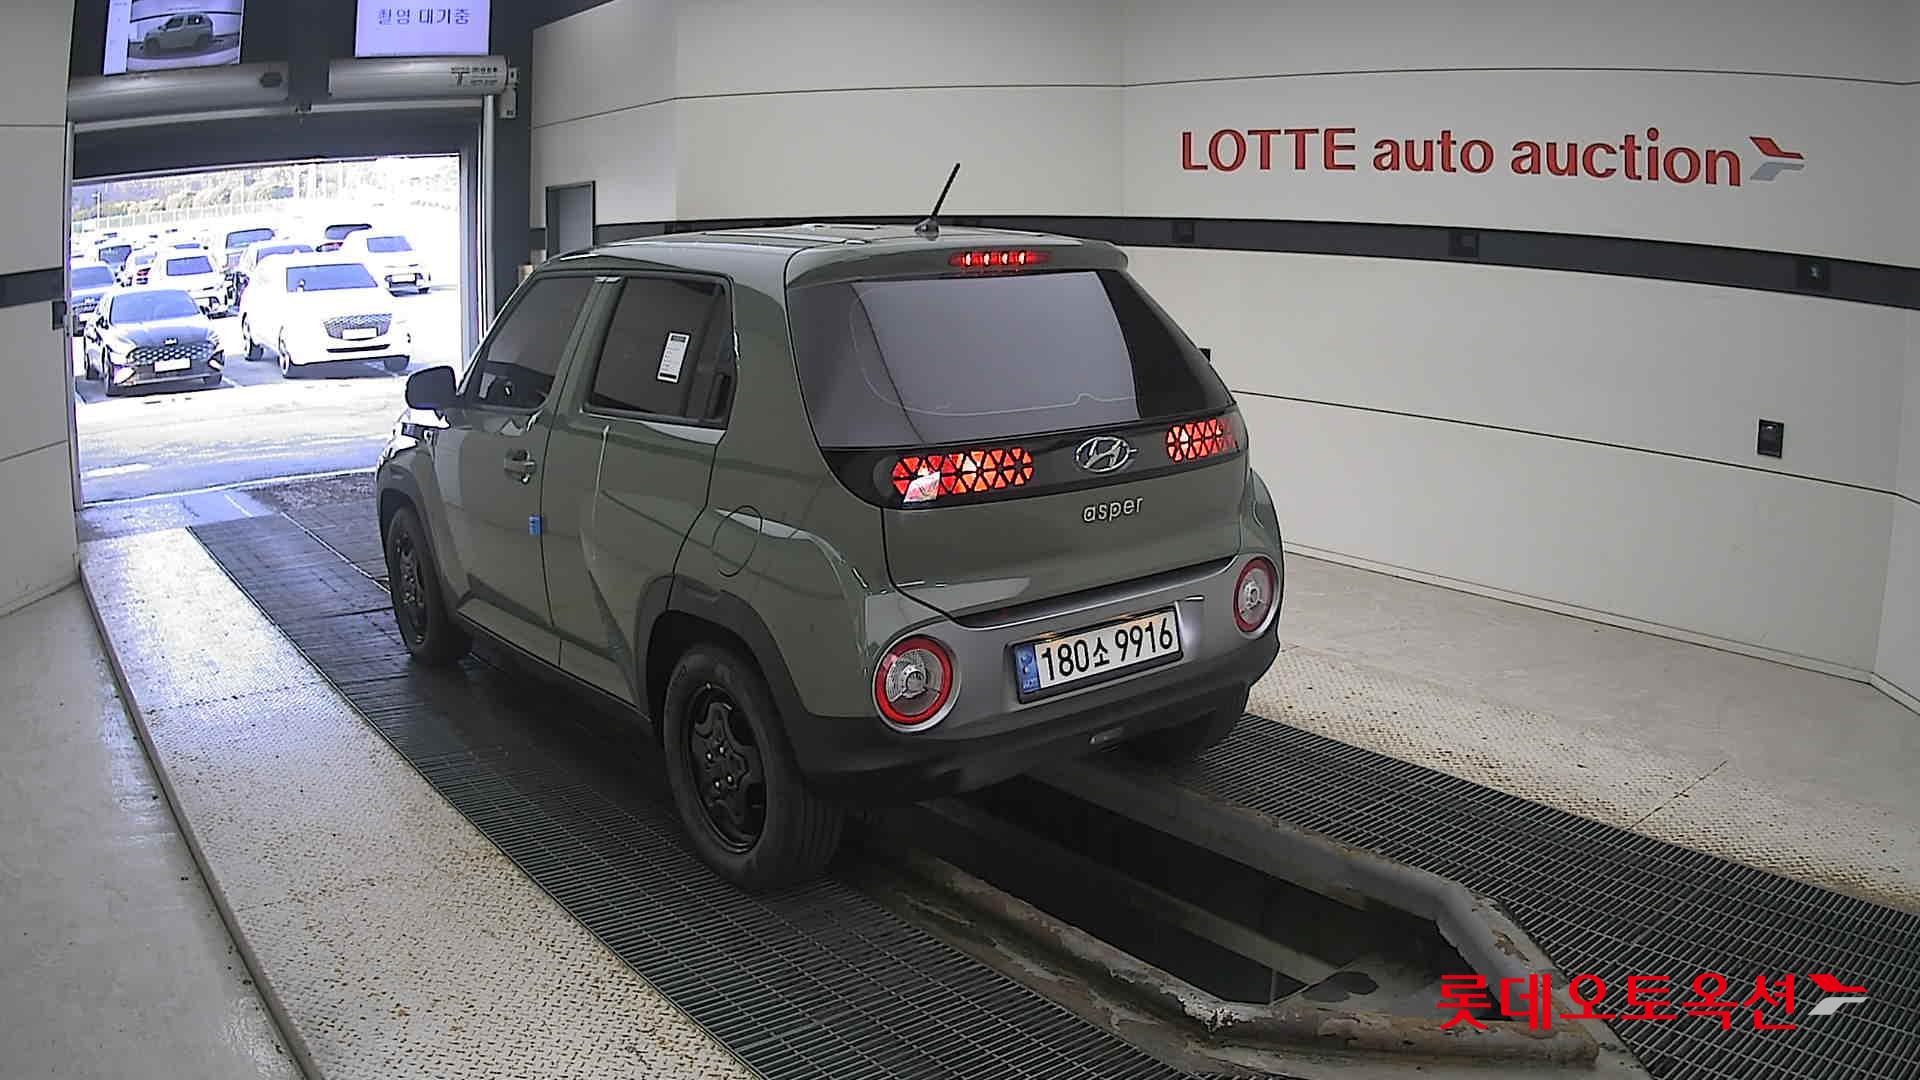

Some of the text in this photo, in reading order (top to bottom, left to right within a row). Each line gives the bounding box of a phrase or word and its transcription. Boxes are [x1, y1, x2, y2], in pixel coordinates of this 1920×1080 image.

[419, 7, 471, 25] 대기중
[1181, 127, 1742, 187] LOTTE auto auction
[1082, 497, 1144, 522] asper
[1041, 617, 1174, 681] 180소 9916
